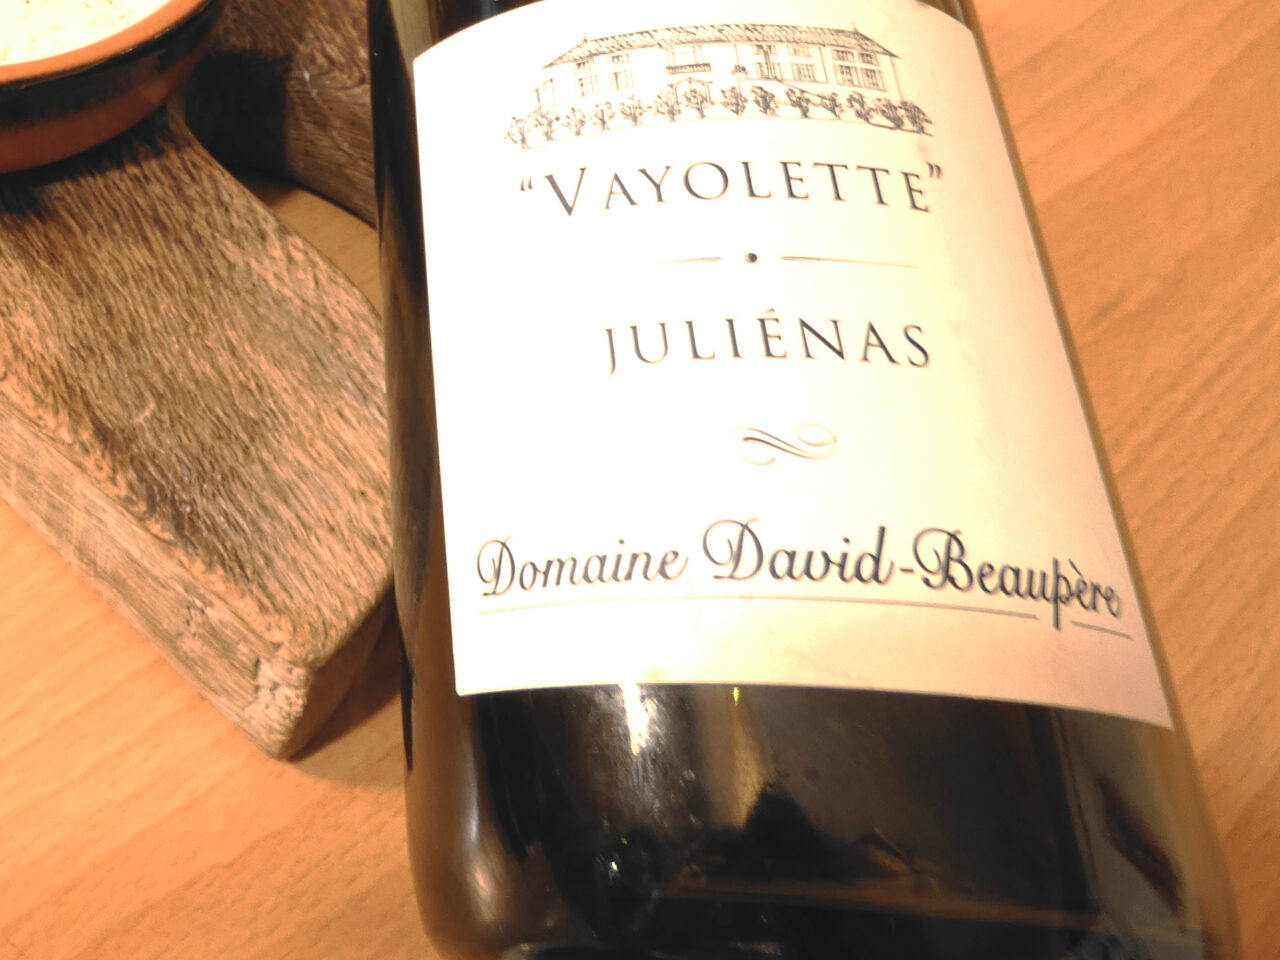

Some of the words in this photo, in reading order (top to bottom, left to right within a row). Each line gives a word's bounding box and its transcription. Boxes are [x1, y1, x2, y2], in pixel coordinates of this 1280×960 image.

[605, 308, 933, 375] JULIÉNAS
[478, 535, 687, 597] Domaine
[702, 519, 1122, 631] David-Beaupère
